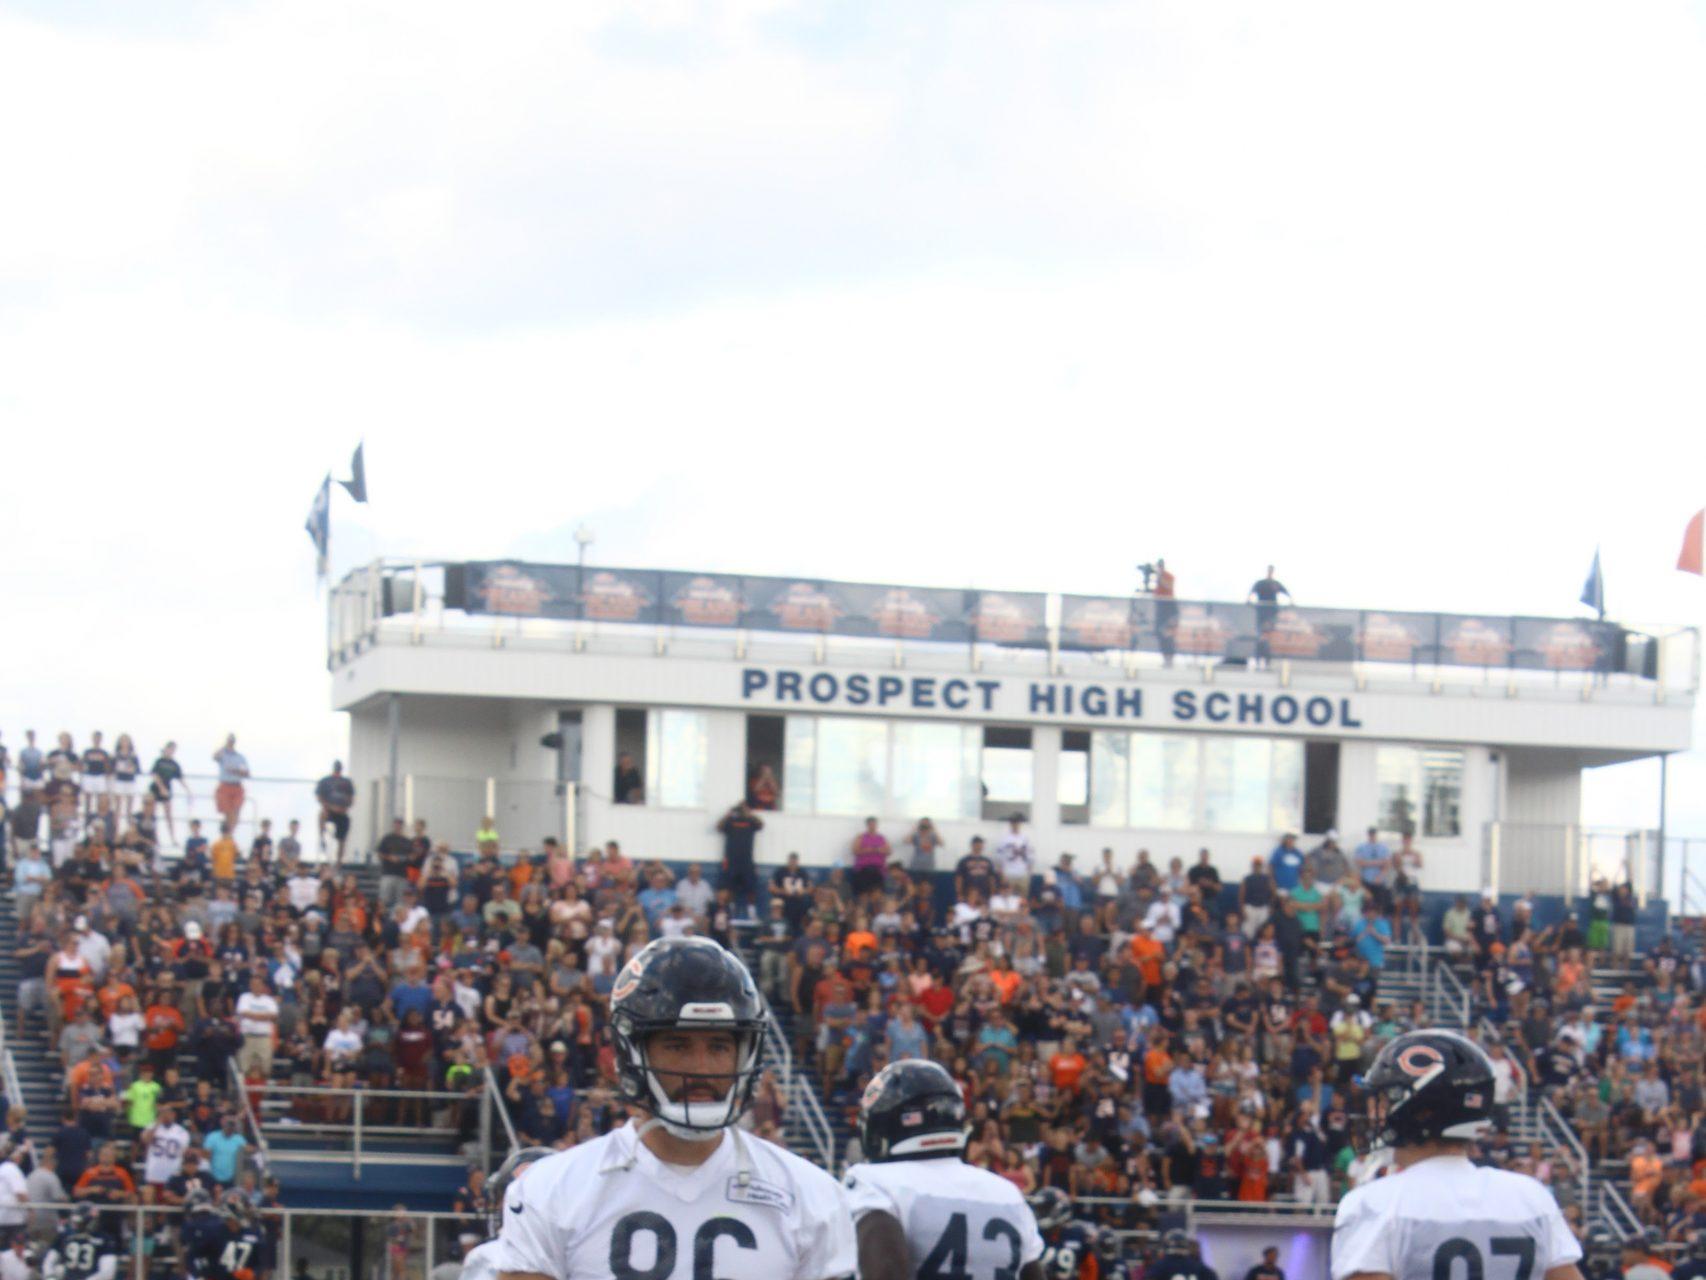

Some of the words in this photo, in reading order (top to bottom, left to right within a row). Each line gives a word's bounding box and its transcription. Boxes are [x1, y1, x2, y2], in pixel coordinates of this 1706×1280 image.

[742, 669, 1001, 711] PROSPECT
[1029, 683, 1142, 717] HIGH
[1171, 690, 1362, 728] SCHOOL
[64, 1242, 95, 1270] 93
[220, 1240, 253, 1272] 47
